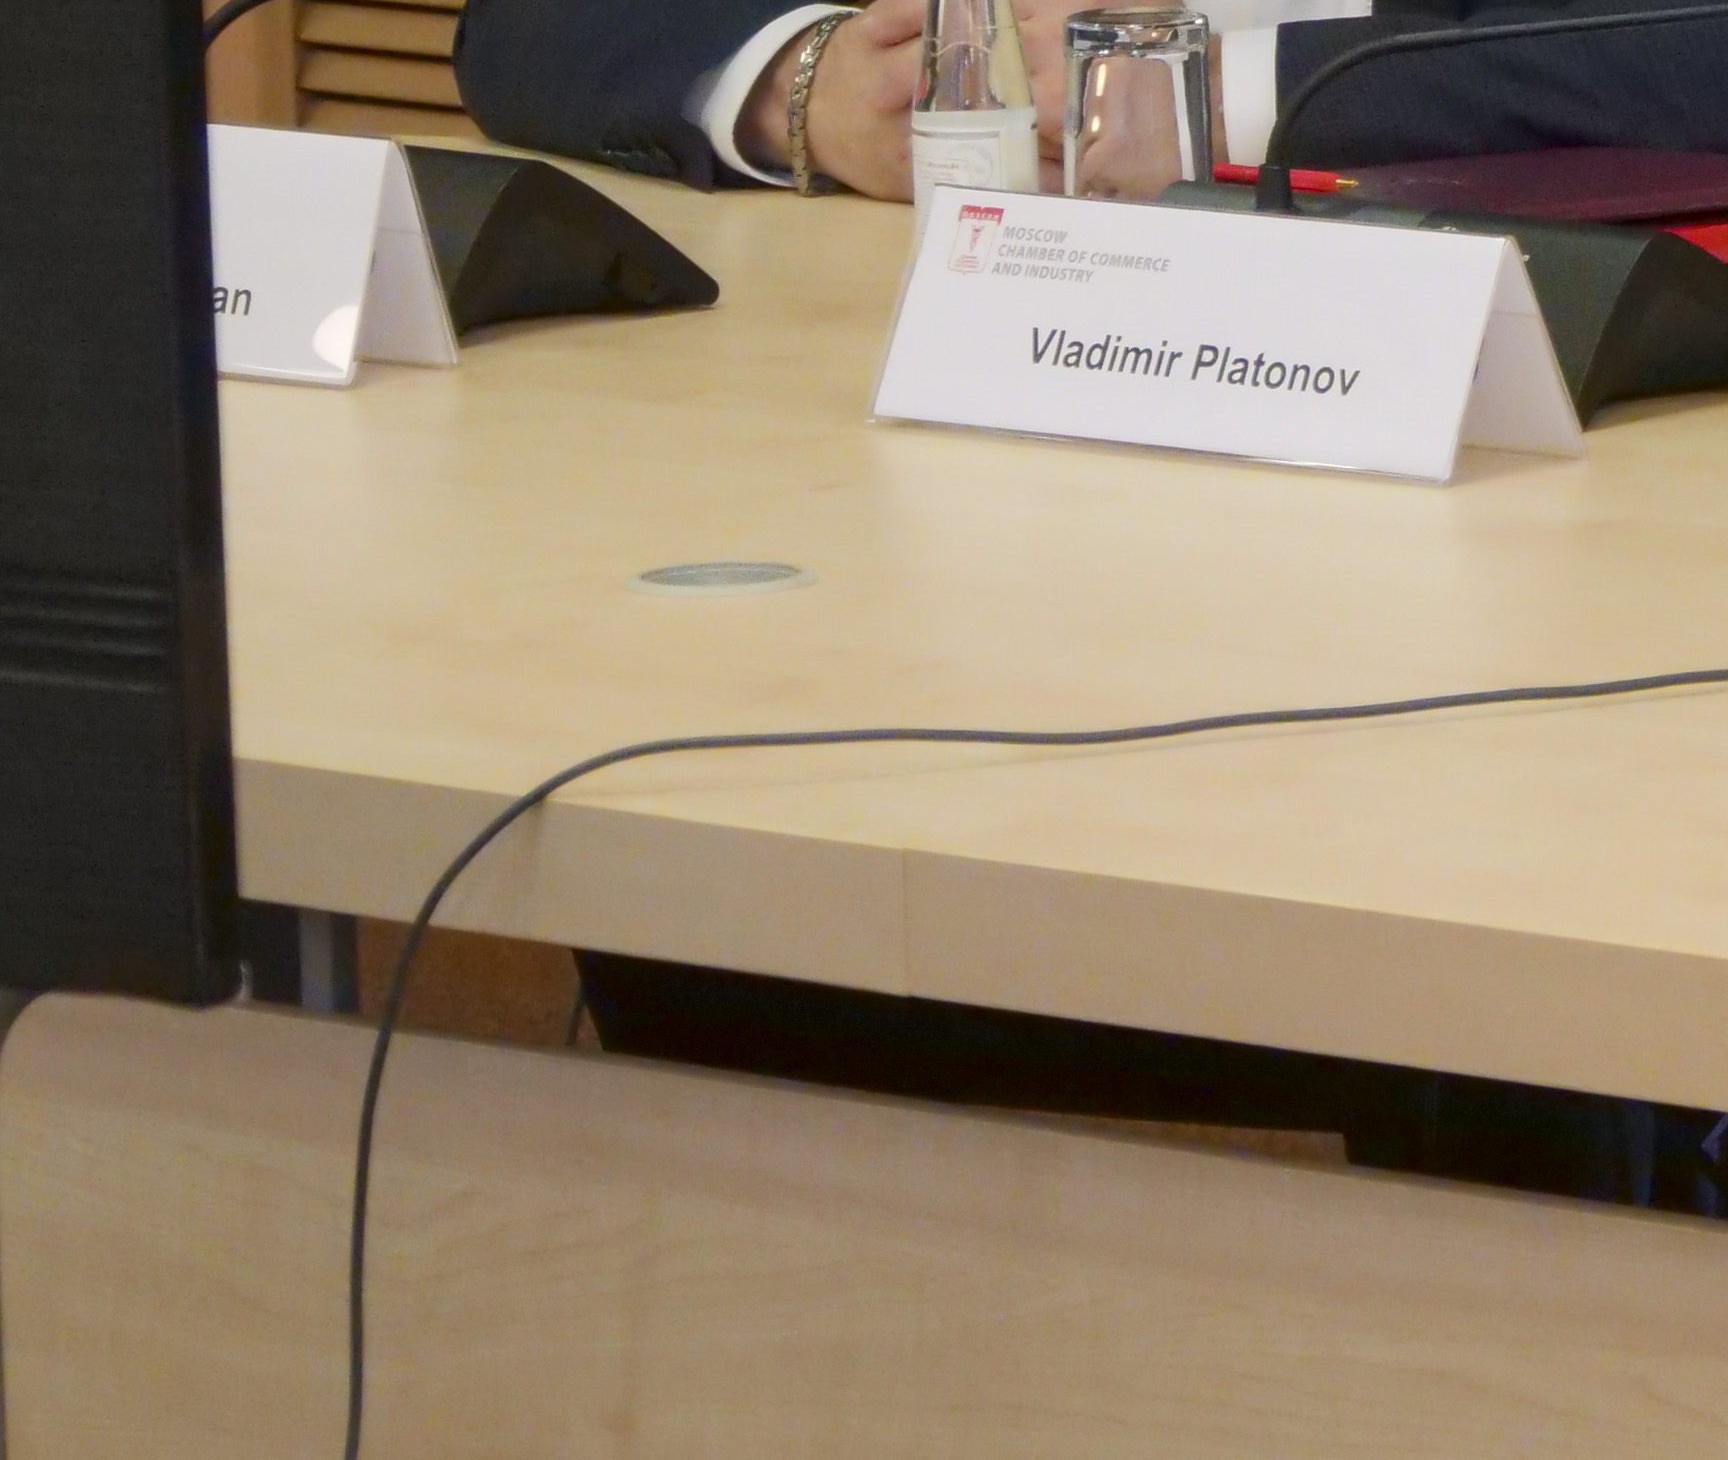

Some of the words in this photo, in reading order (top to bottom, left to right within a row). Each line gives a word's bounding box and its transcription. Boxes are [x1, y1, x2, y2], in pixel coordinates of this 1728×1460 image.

[1002, 225, 1069, 244] MOSCOW
[997, 243, 1066, 263] CHAMBER
[1068, 250, 1088, 264] OF
[1089, 251, 1170, 272] COMMERCE
[991, 262, 1022, 277] AND
[1024, 264, 1095, 283] INDUSTRY
[1032, 326, 1184, 378] Vladimir
[1190, 343, 1361, 397] Platonov
